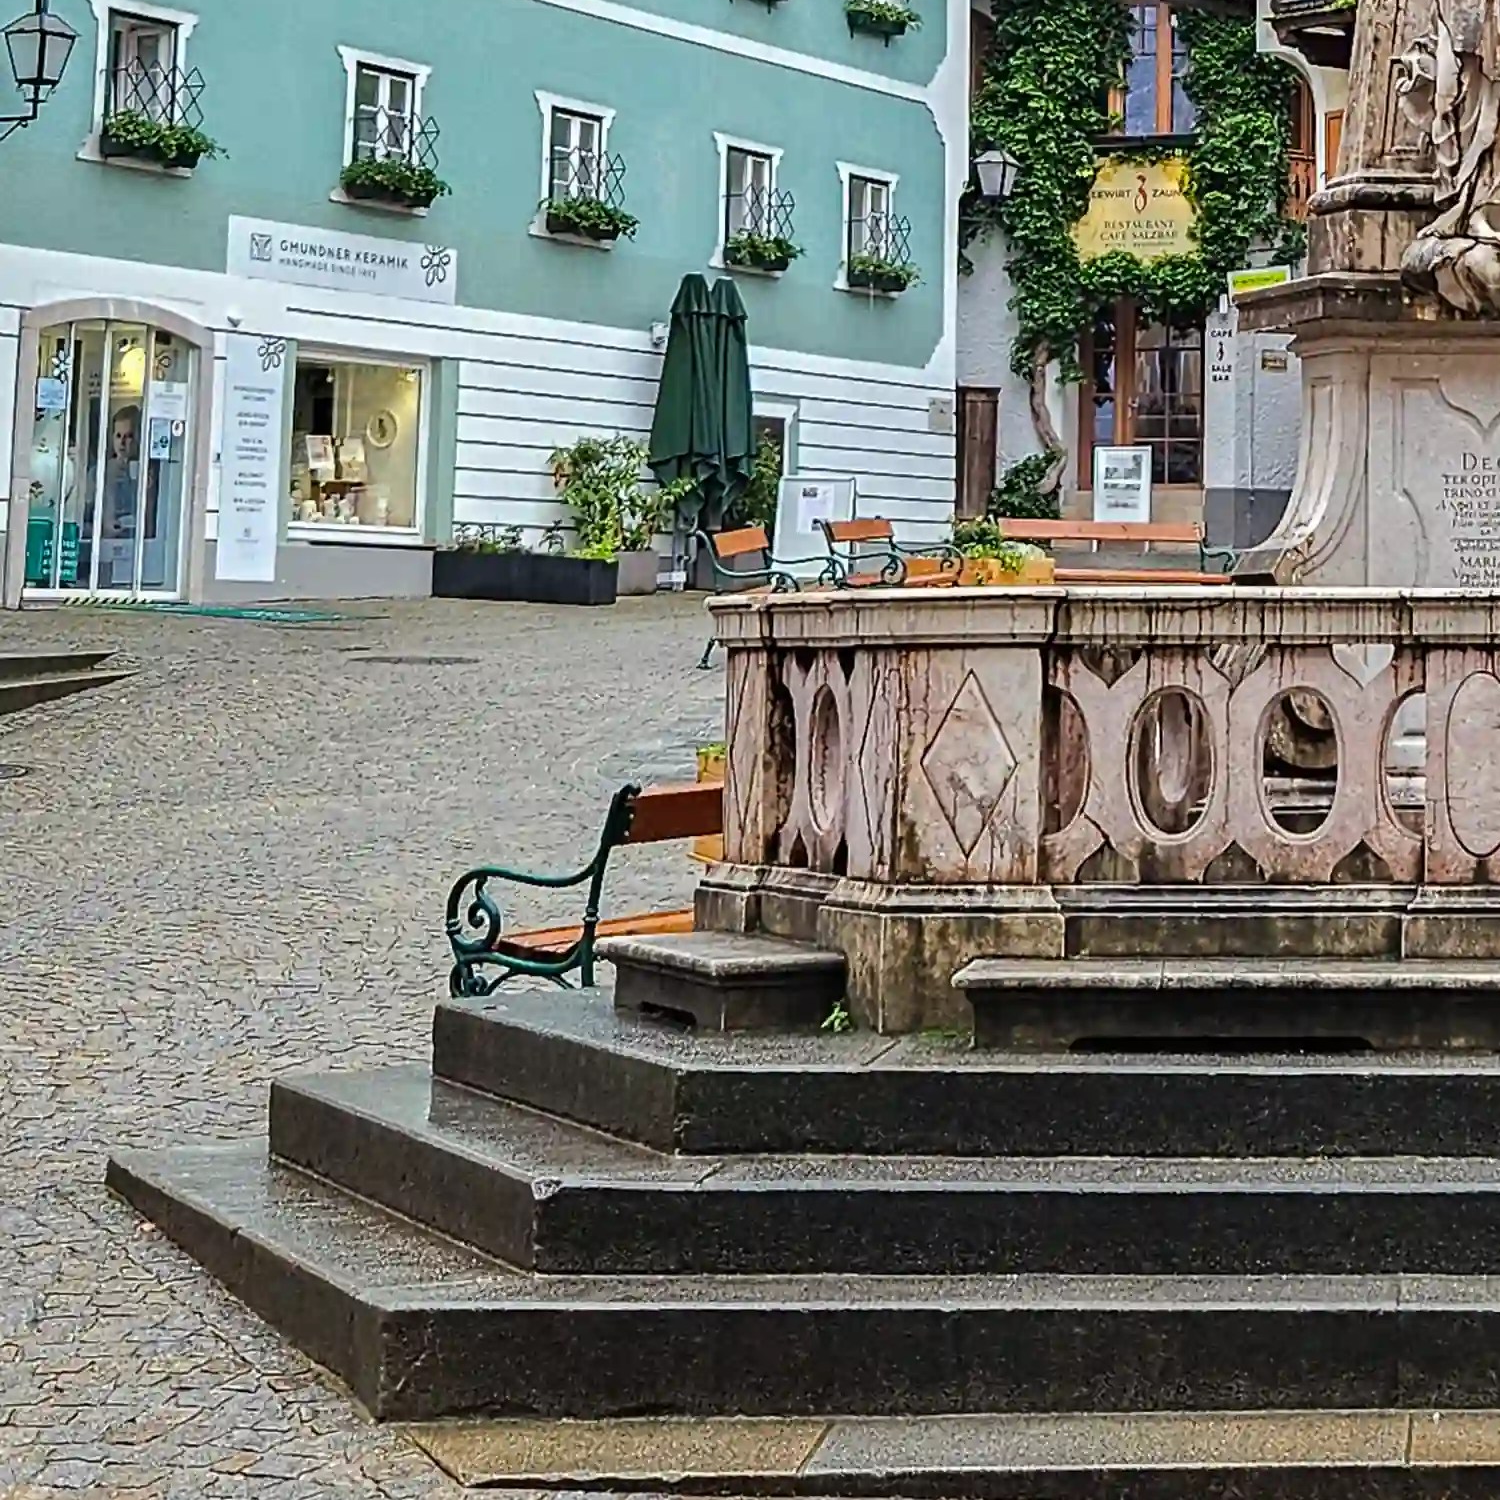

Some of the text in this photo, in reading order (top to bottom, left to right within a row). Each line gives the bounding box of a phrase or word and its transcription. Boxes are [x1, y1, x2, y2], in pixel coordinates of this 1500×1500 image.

[1104, 220, 1175, 230] RESTAURANT
[279, 239, 408, 269] GMUNDNER KERAMIK
